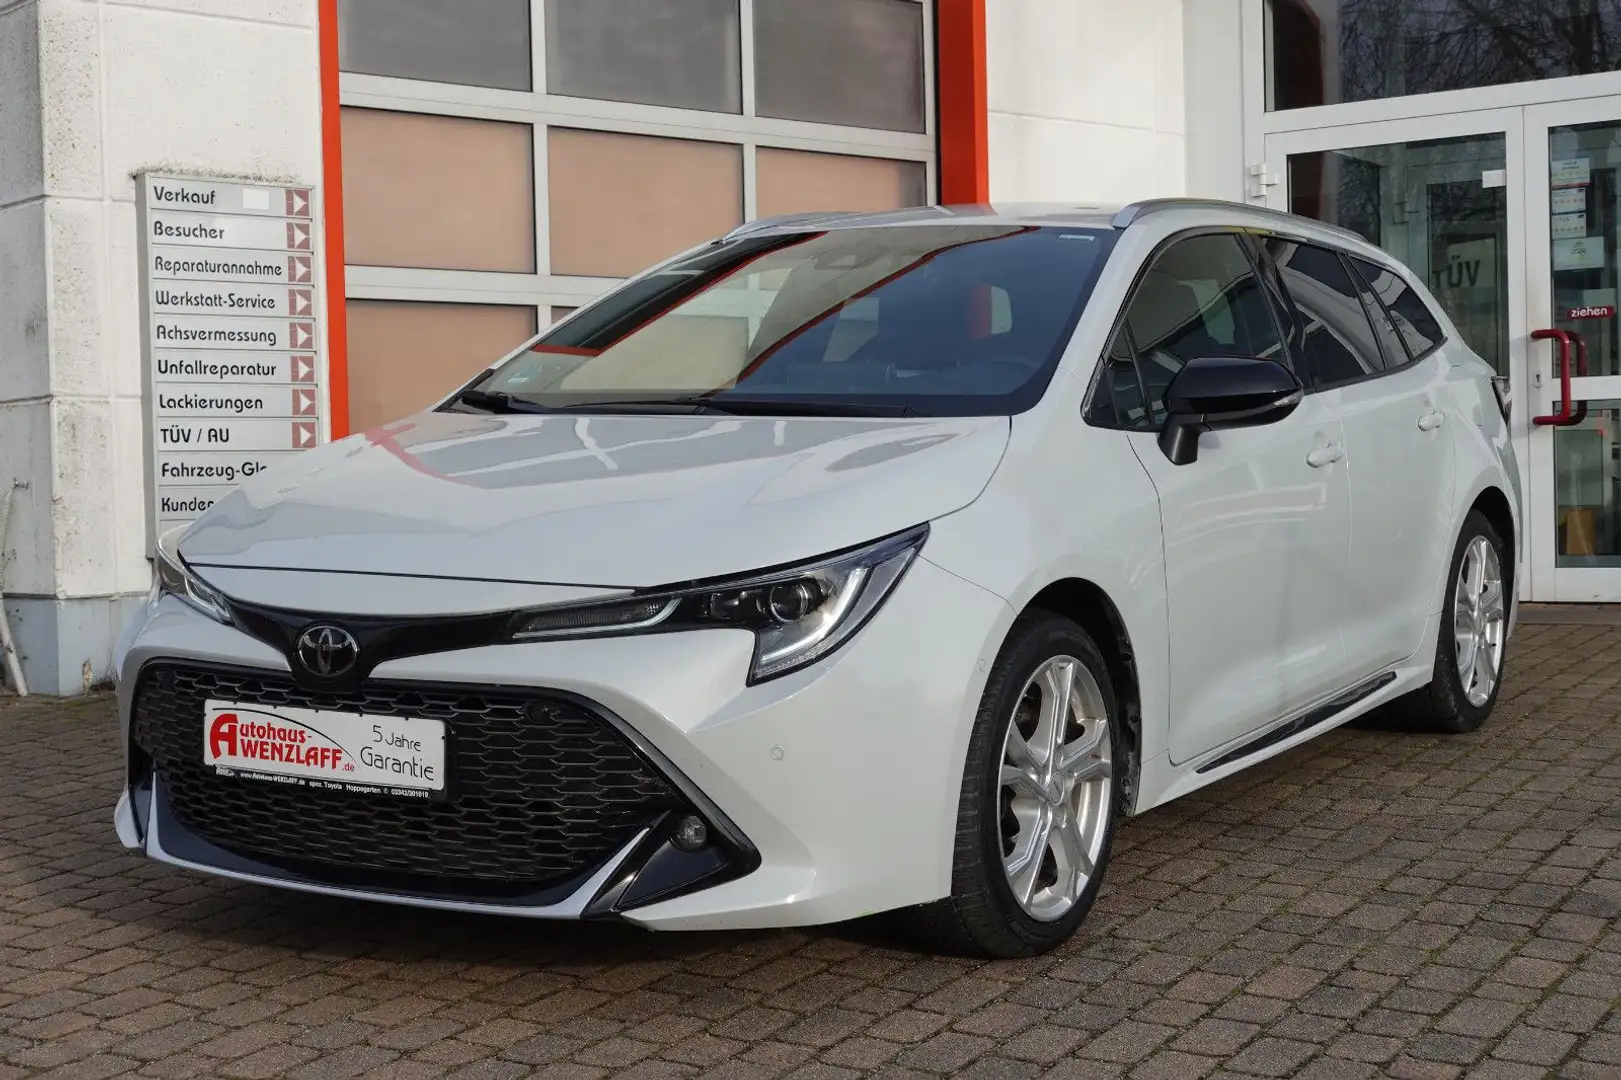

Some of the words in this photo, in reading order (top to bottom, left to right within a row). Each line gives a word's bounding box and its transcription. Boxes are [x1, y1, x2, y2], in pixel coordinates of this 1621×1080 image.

[153, 185, 216, 205] Verkauf
[153, 220, 225, 240] Besucher
[154, 255, 283, 276] Reparaturannahme
[155, 290, 276, 309] Werkstatt-Service
[1571, 307, 1608, 318] ziehen
[156, 324, 277, 346] Achsvermessung
[157, 358, 277, 379] Unfallreparatur
[159, 393, 264, 414] Lackierungen
[160, 424, 192, 444] TÜV
[196, 428, 203, 443] /
[207, 428, 230, 443] AU
[372, 724, 383, 744] 5
[385, 732, 422, 753] Jahre
[360, 746, 435, 782] Garantie
[324, 781, 343, 790] Toyota
